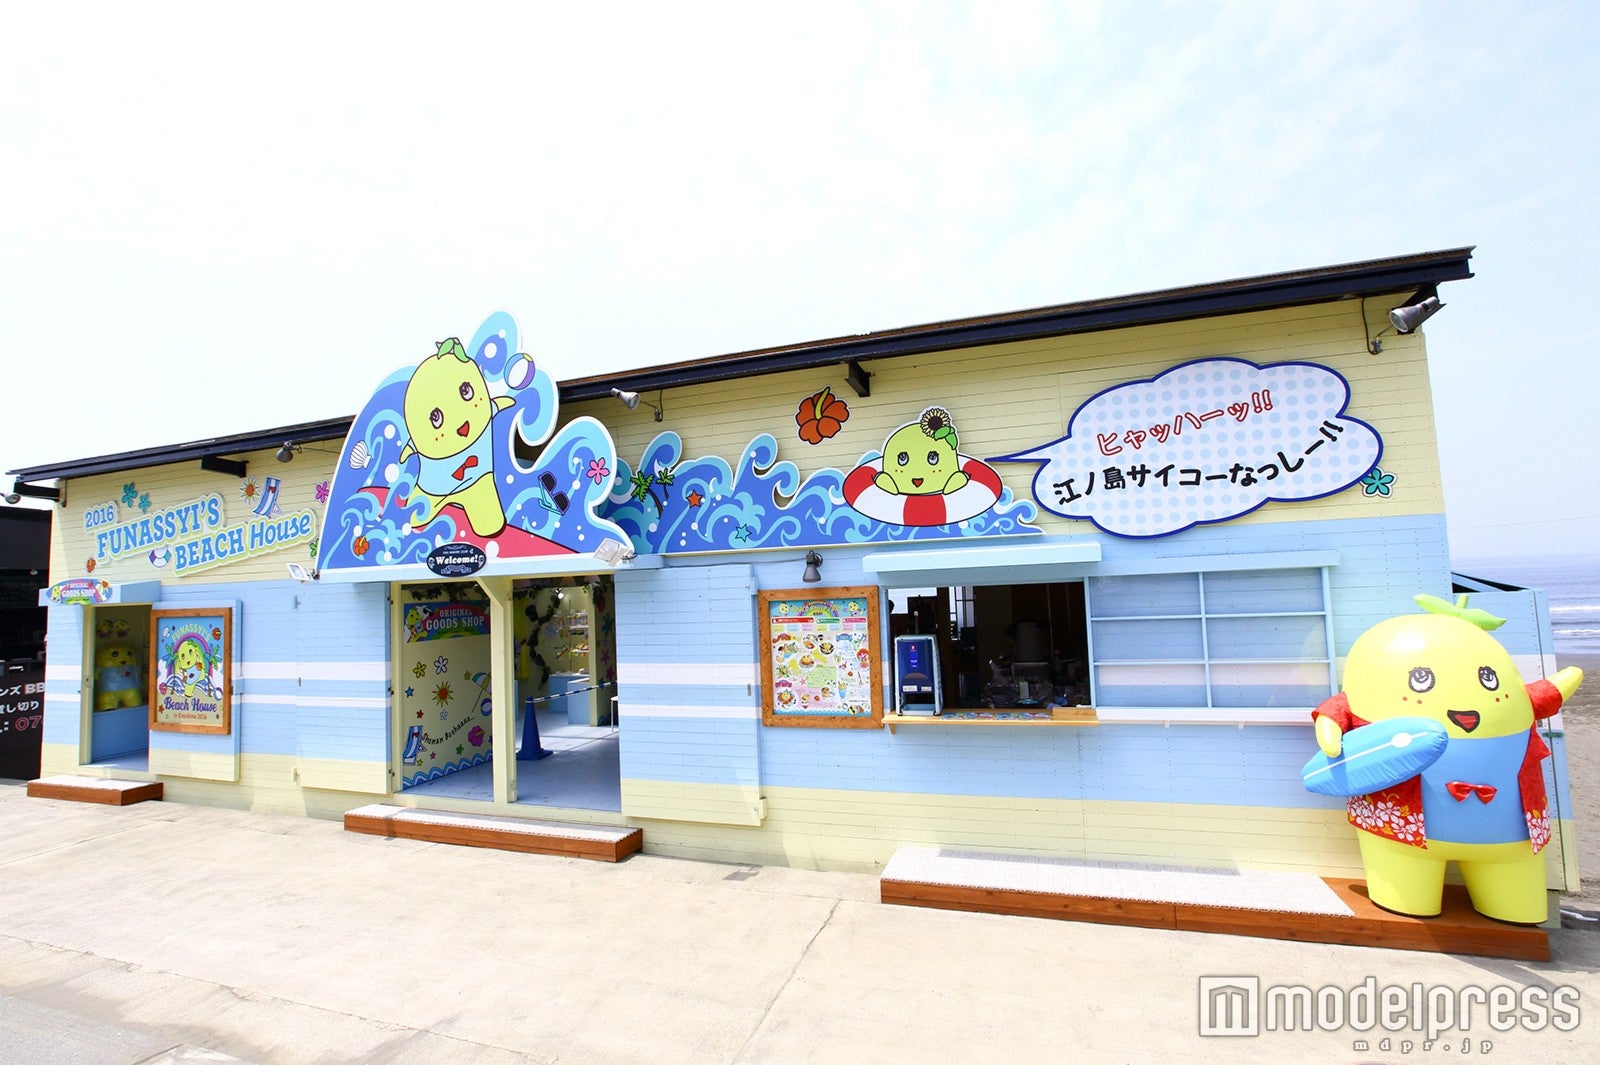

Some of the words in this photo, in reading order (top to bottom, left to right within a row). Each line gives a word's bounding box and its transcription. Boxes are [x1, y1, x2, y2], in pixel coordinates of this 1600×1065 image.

[1053, 420, 1344, 505] 江ノ島サイコーなっしー!!
[85, 505, 115, 527] 2016
[97, 498, 220, 558] FUNASSYI'S
[175, 528, 244, 570] BEACH
[250, 514, 310, 549] House
[436, 555, 478, 565] Welcome!
[426, 618, 458, 630] GOODS
[462, 616, 485, 627] SHOP
[164, 697, 189, 711] Beach
[192, 698, 217, 712] House
